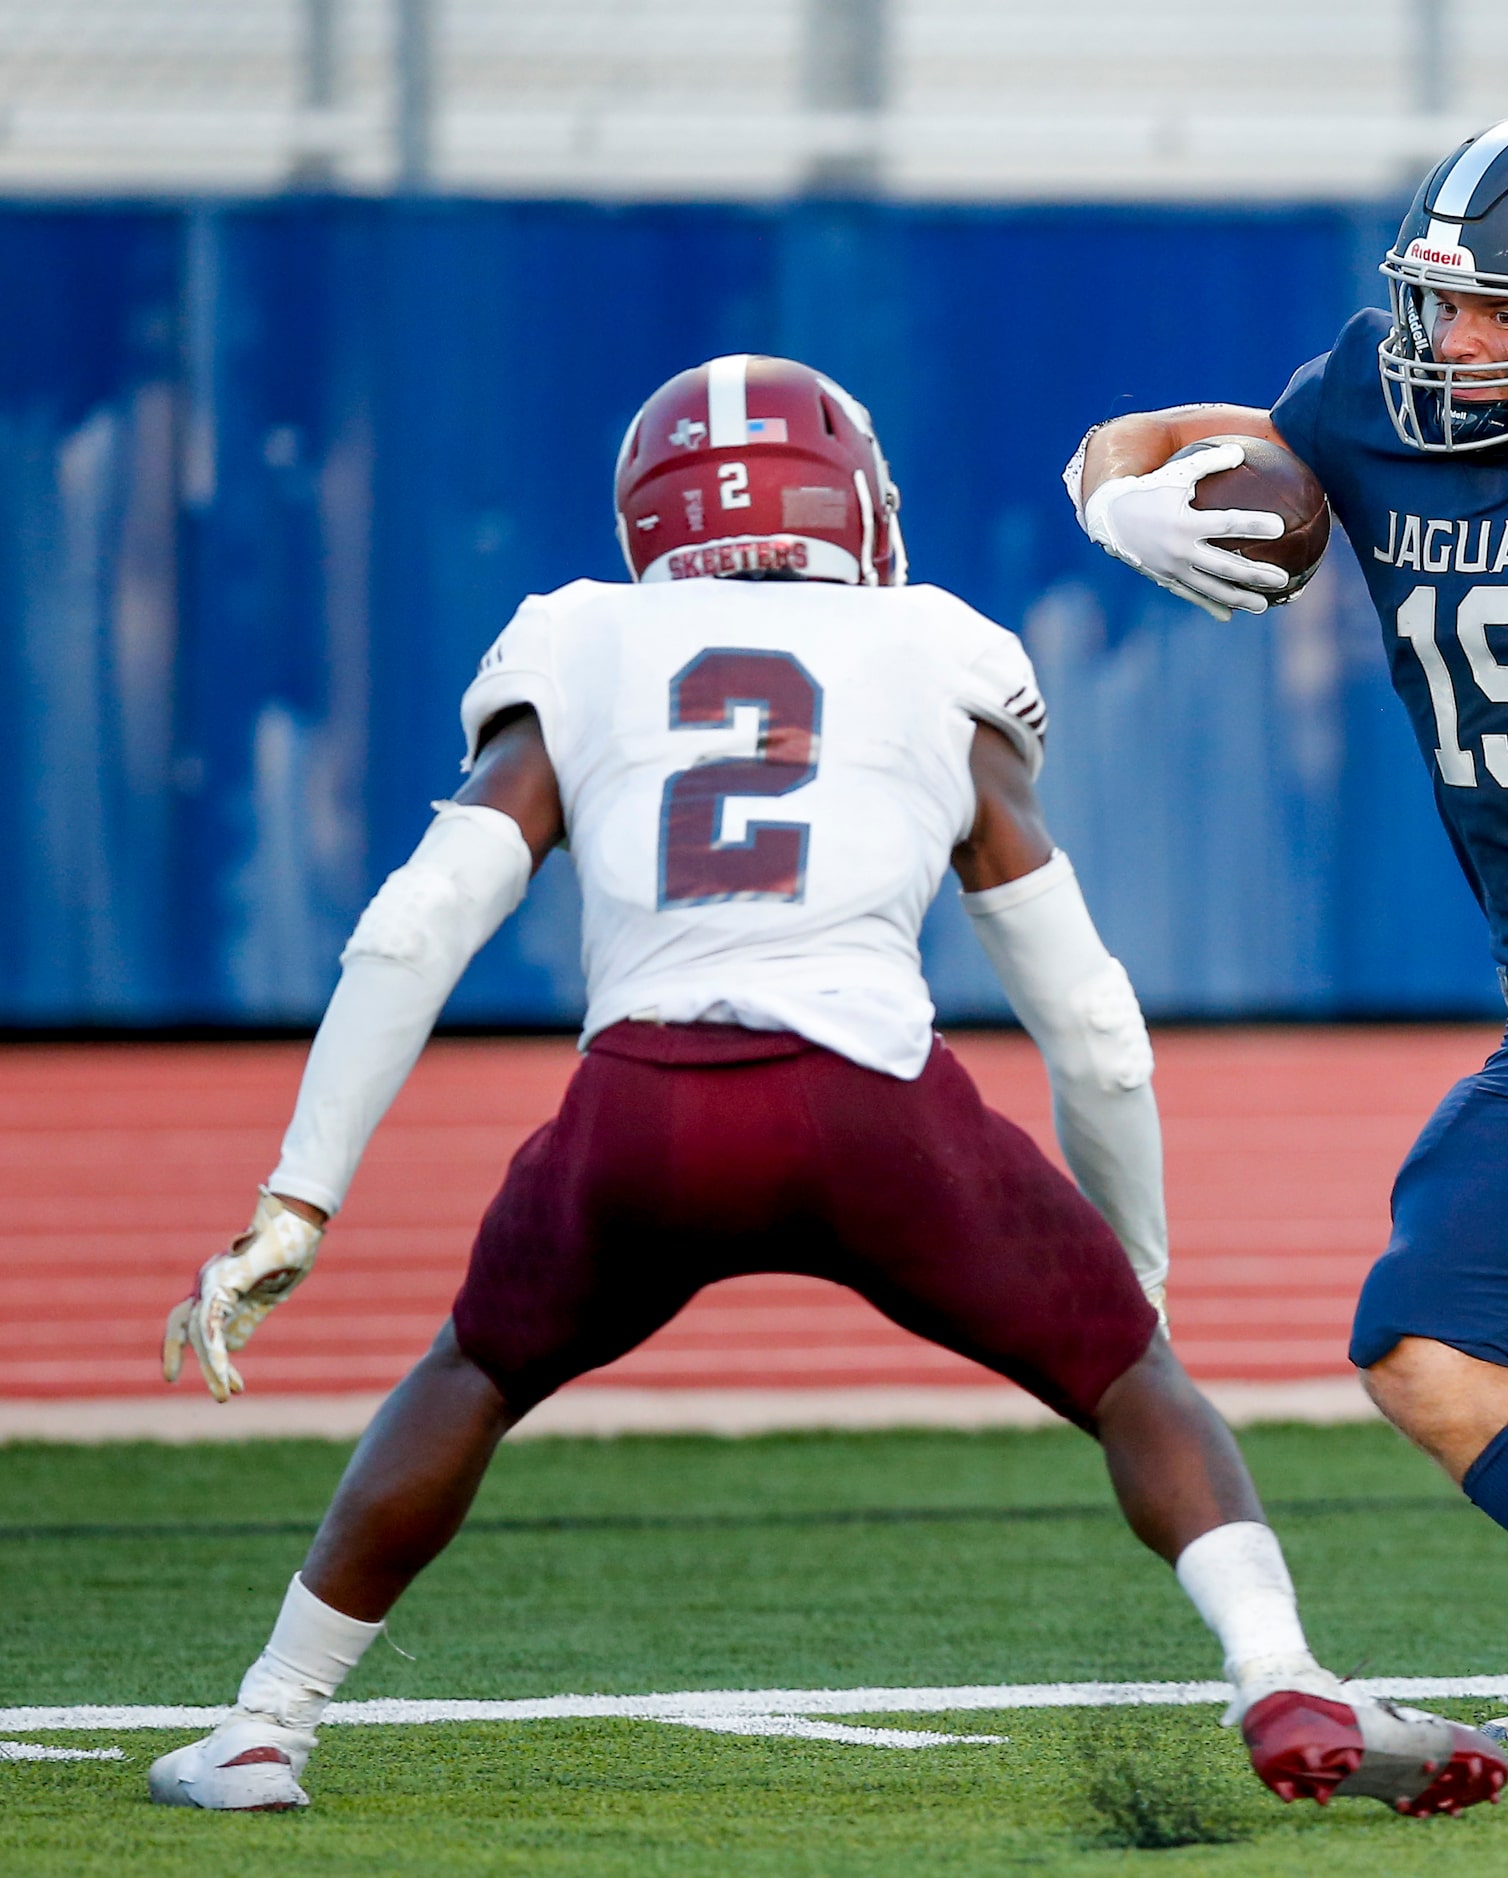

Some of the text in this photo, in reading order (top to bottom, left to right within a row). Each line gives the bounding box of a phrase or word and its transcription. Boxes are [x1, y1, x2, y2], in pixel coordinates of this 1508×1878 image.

[1411, 243, 1462, 266] Riddell
[717, 461, 751, 511] 2
[668, 540, 807, 580] SKEETERS
[655, 646, 824, 913] 2
